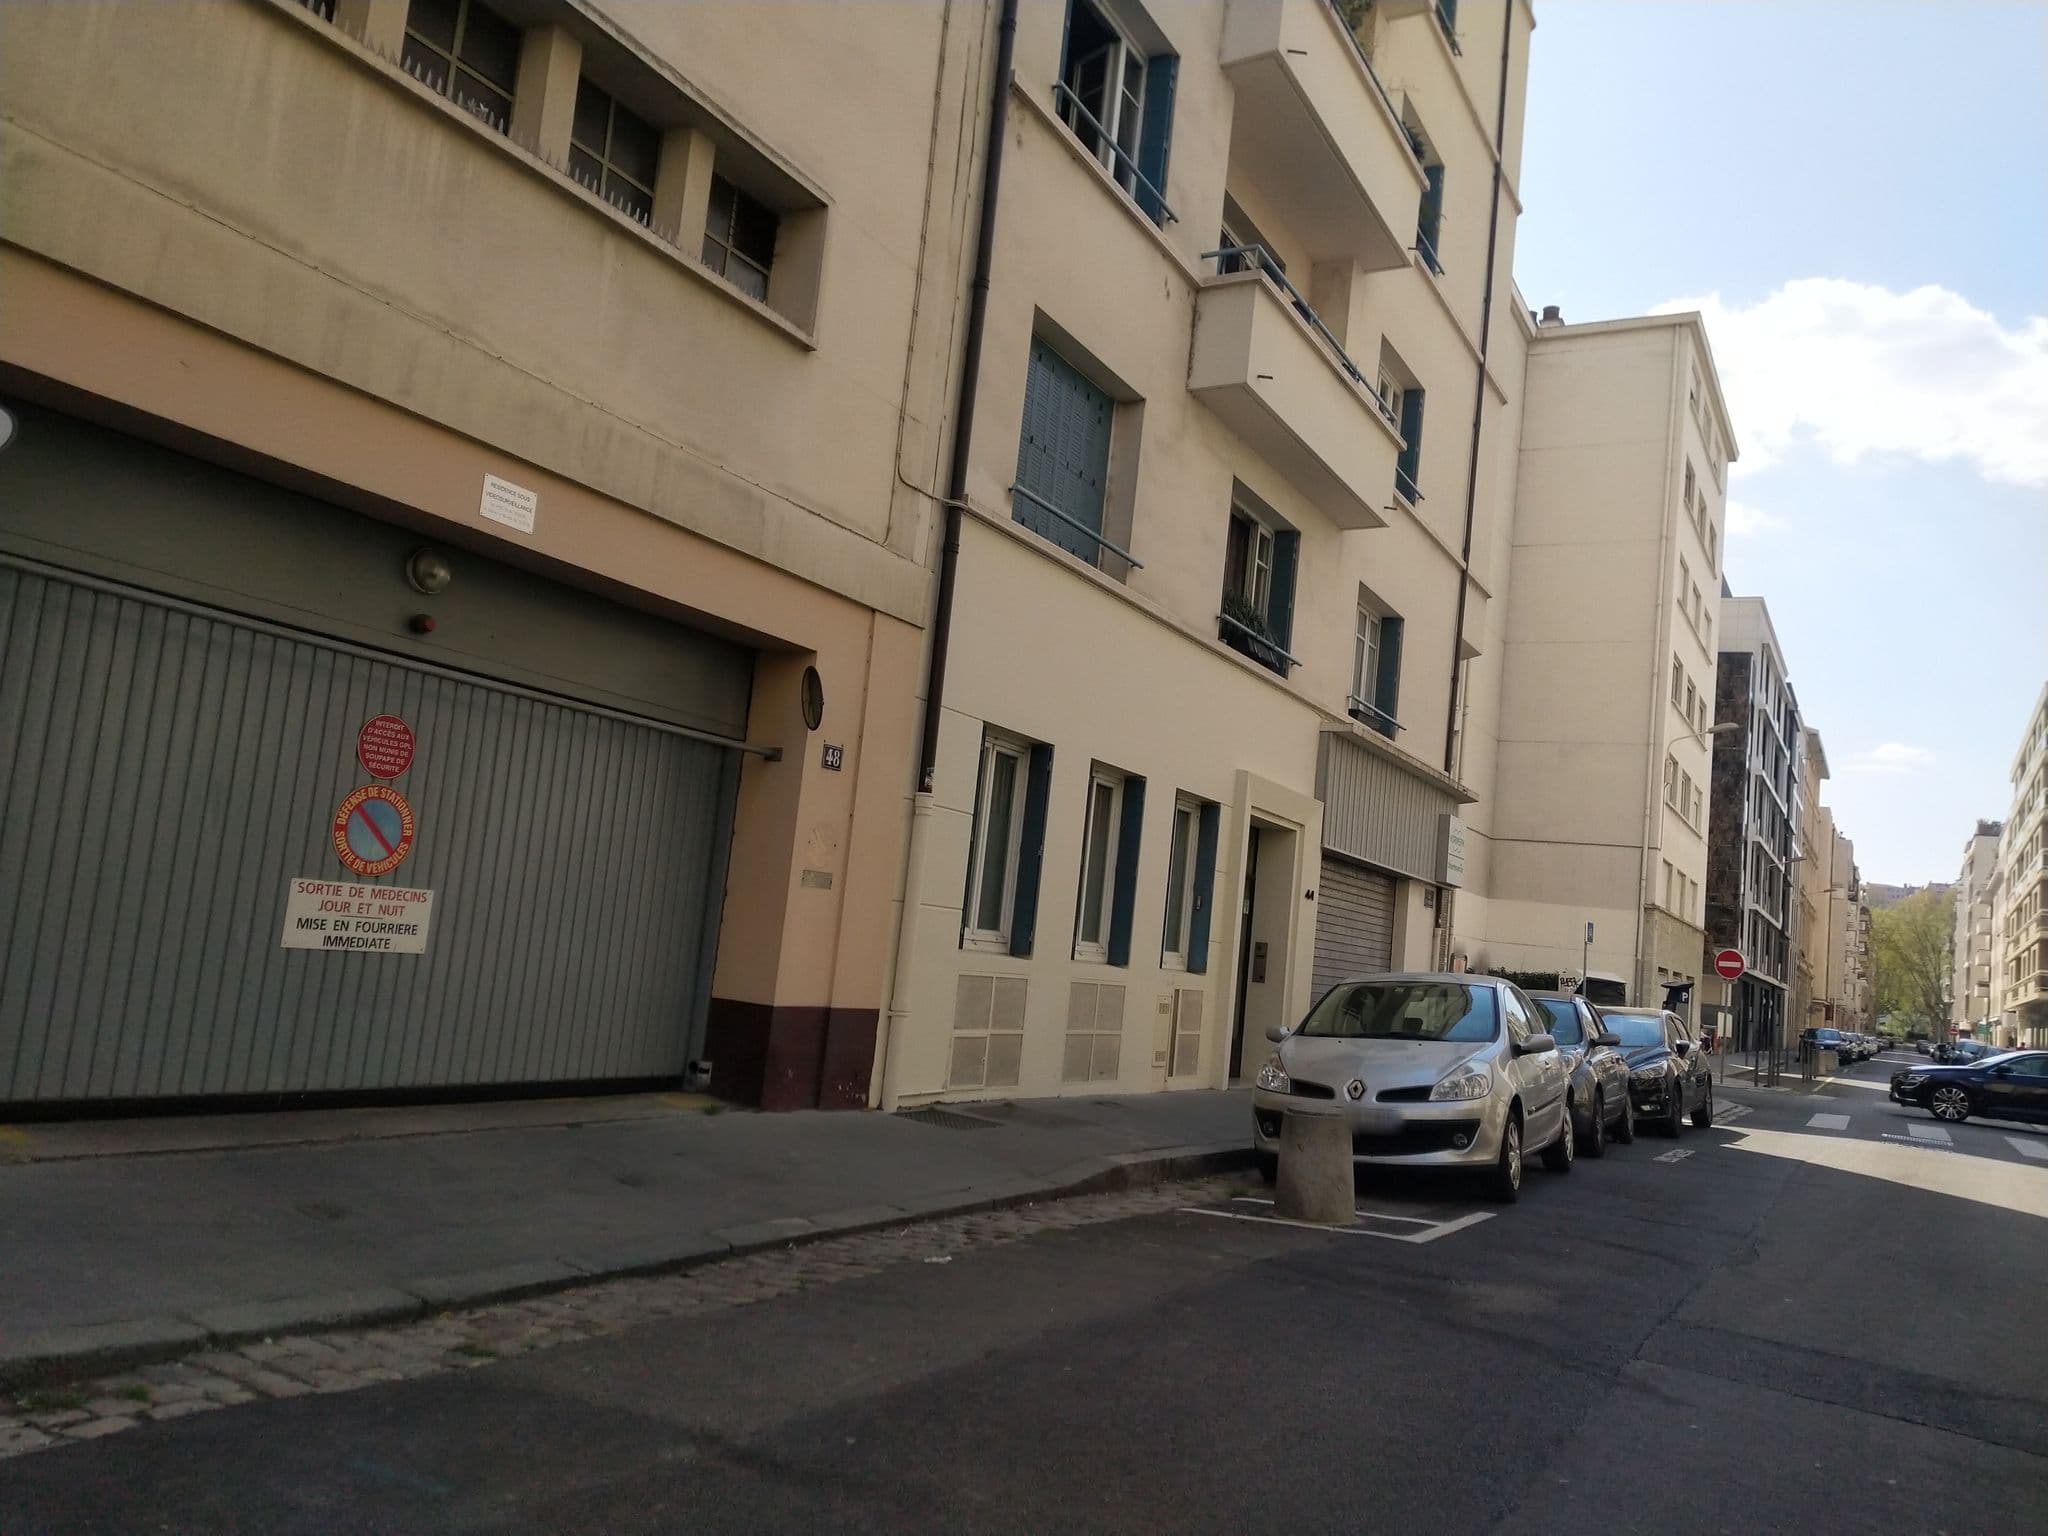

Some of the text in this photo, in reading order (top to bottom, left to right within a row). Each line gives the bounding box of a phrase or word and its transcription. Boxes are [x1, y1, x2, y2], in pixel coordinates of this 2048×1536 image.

[376, 720, 405, 731] INTERDIT
[363, 743, 409, 758] NON MUNIS DE
[399, 741, 412, 750] GPL
[365, 753, 406, 766] SOUPAPE DE
[825, 748, 840, 767] 48
[367, 787, 379, 797] DE
[380, 788, 413, 836] STATIONNER
[335, 831, 355, 865] SORTIE
[353, 858, 366, 871] DE
[297, 881, 427, 903] SORTIE DE MEDECINS
[318, 900, 406, 917] JOUR ET NUIT
[296, 917, 419, 936] MISE EN FOURRIERE
[322, 935, 391, 950] IMMEDIATE
[1681, 992, 1689, 1002] P
